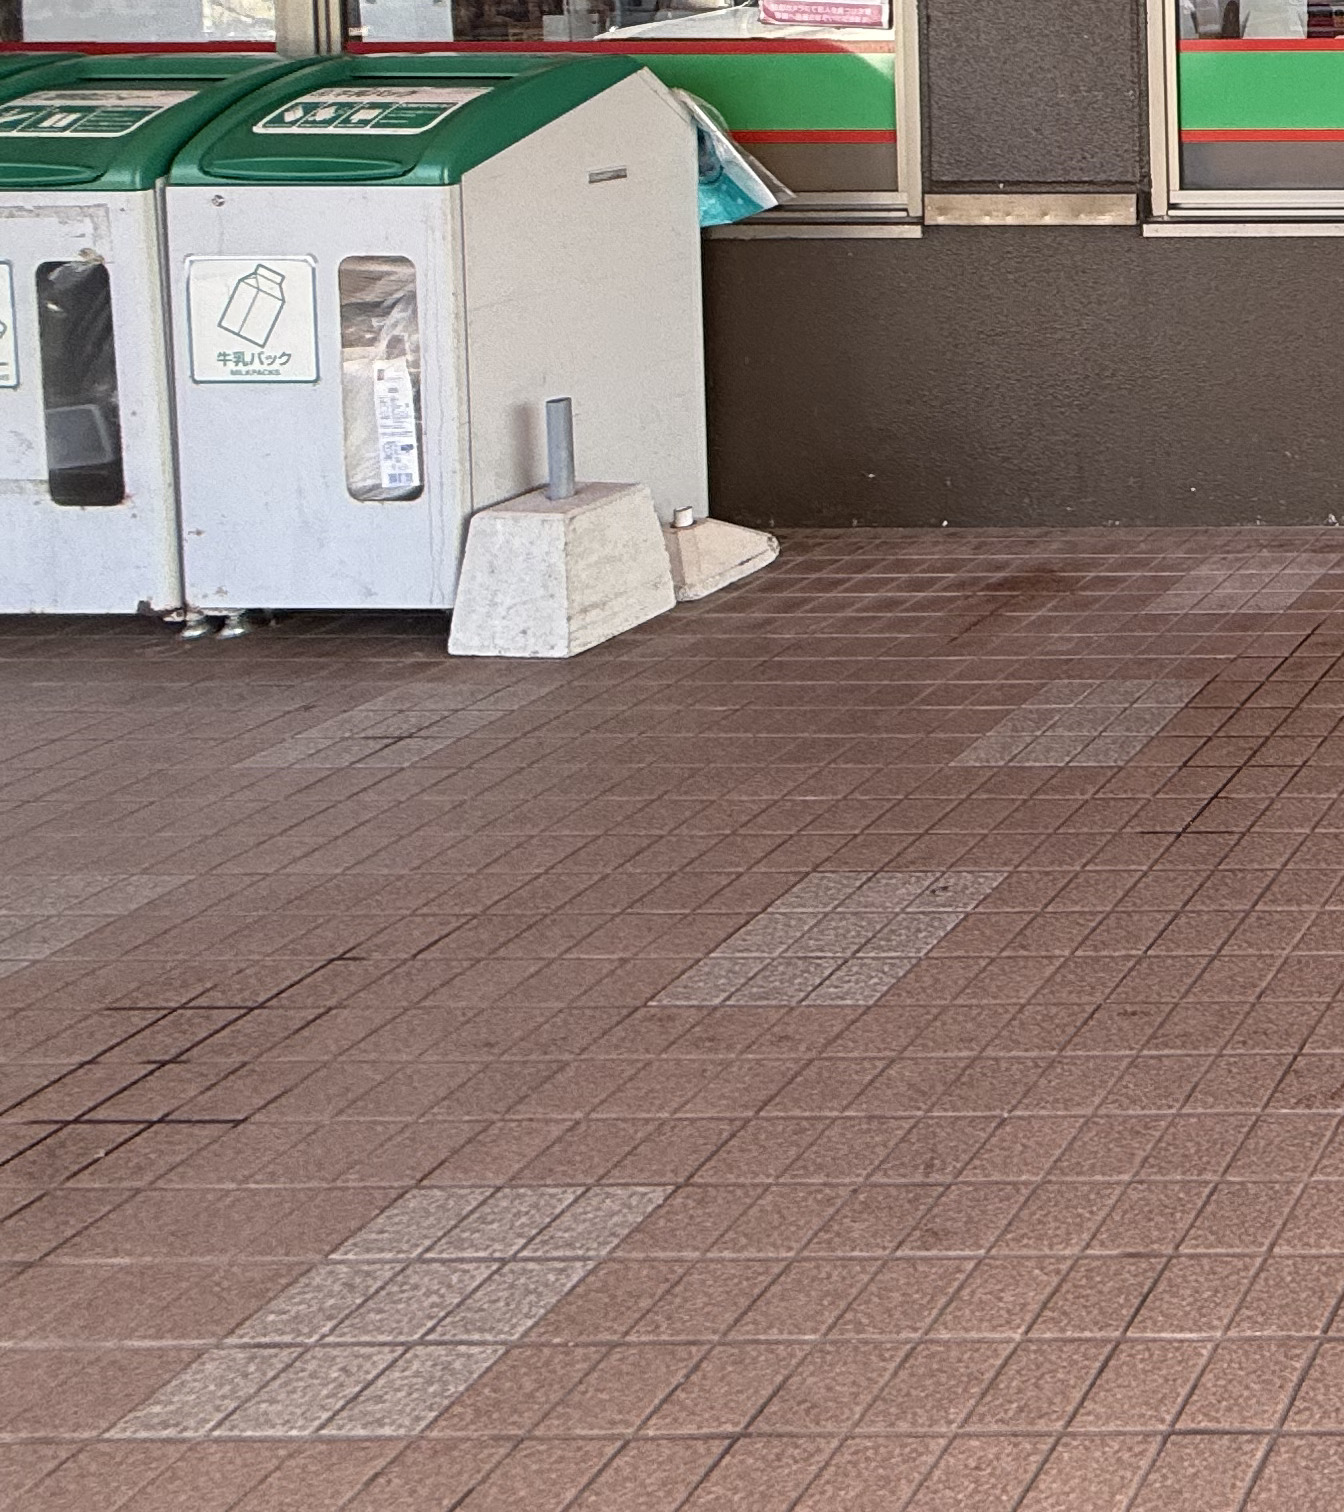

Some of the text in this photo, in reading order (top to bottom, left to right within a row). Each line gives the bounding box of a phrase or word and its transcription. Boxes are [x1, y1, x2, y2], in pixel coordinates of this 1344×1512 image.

[217, 351, 292, 367] 牛乳パック
